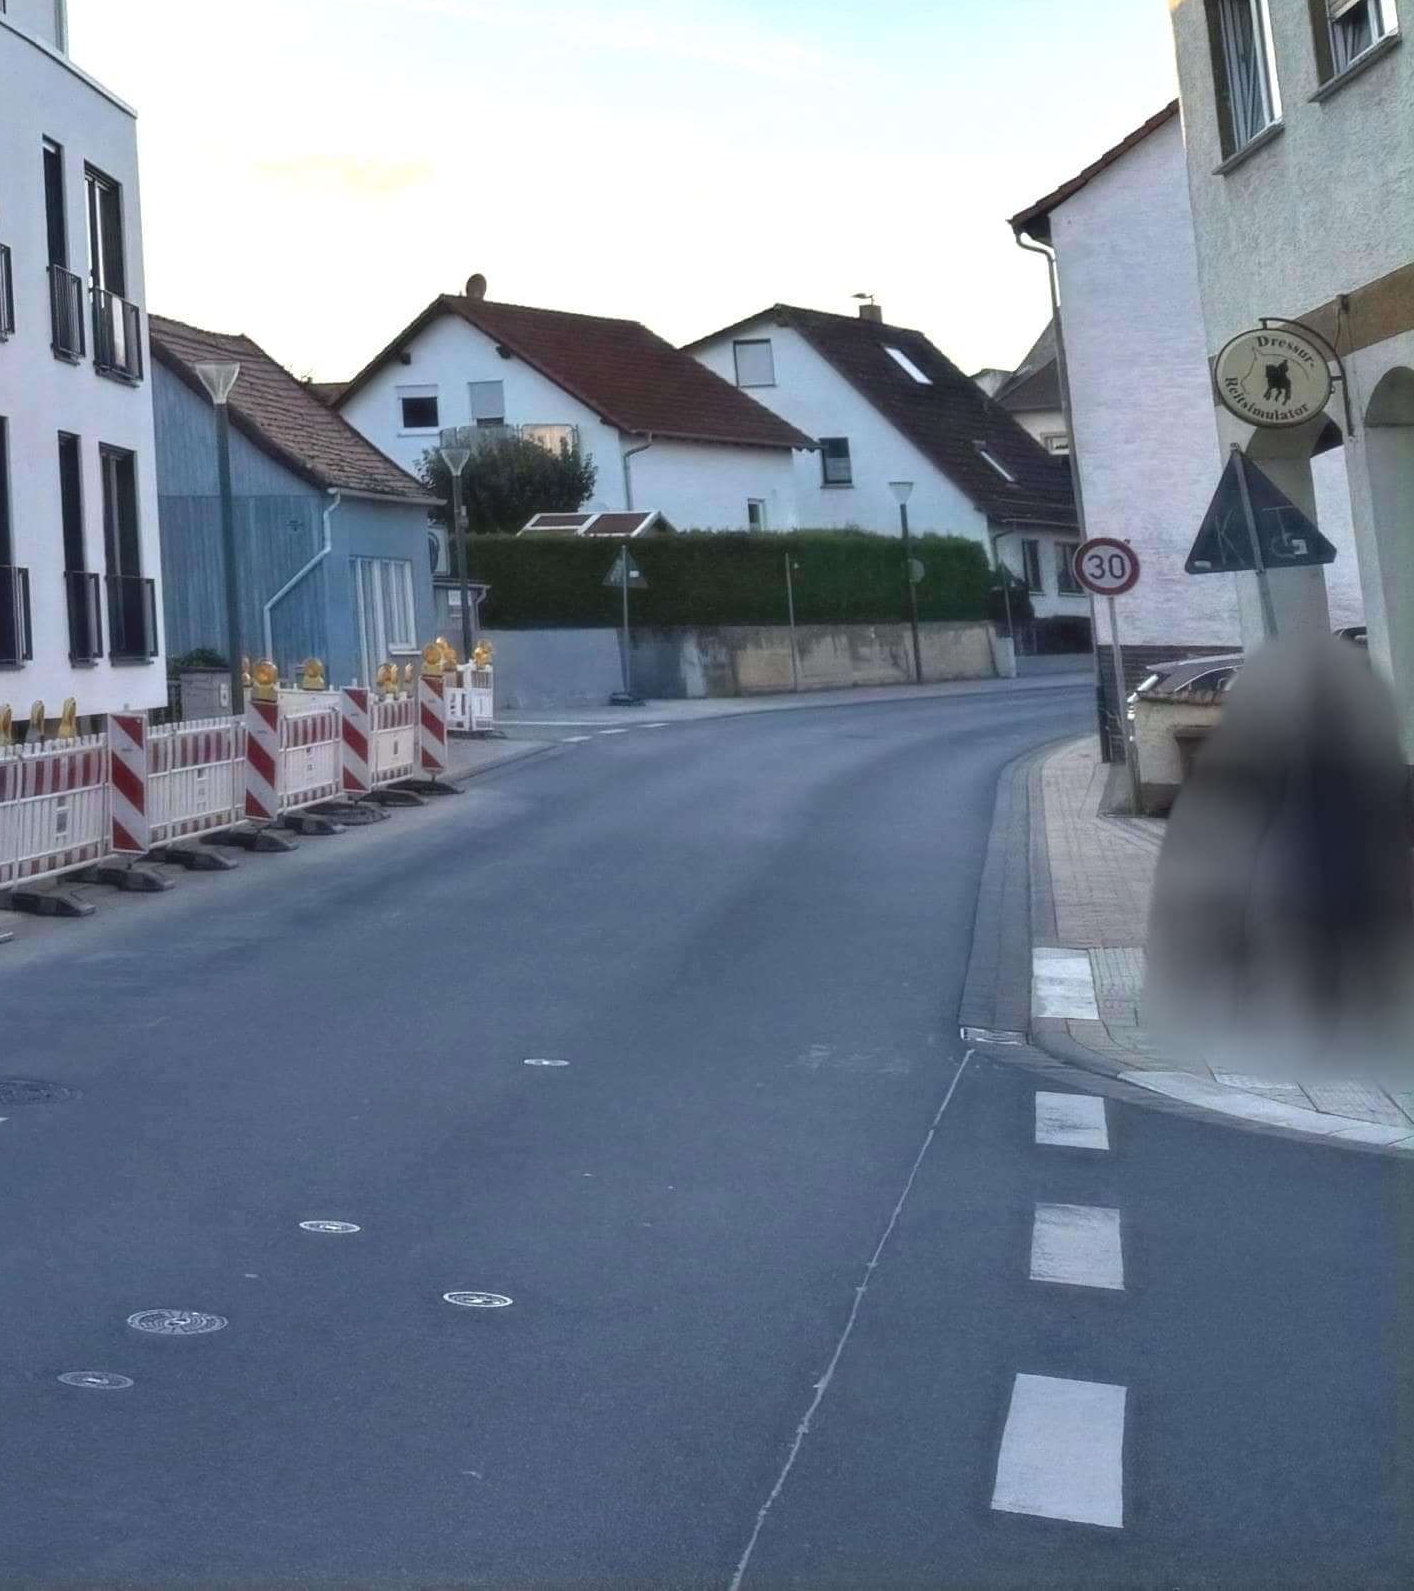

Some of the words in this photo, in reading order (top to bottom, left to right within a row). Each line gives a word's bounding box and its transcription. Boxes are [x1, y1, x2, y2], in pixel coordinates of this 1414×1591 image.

[1257, 336, 1315, 367] Dressur-
[1224, 377, 1310, 421] Reitsimulator
[1087, 553, 1126, 580] 30
